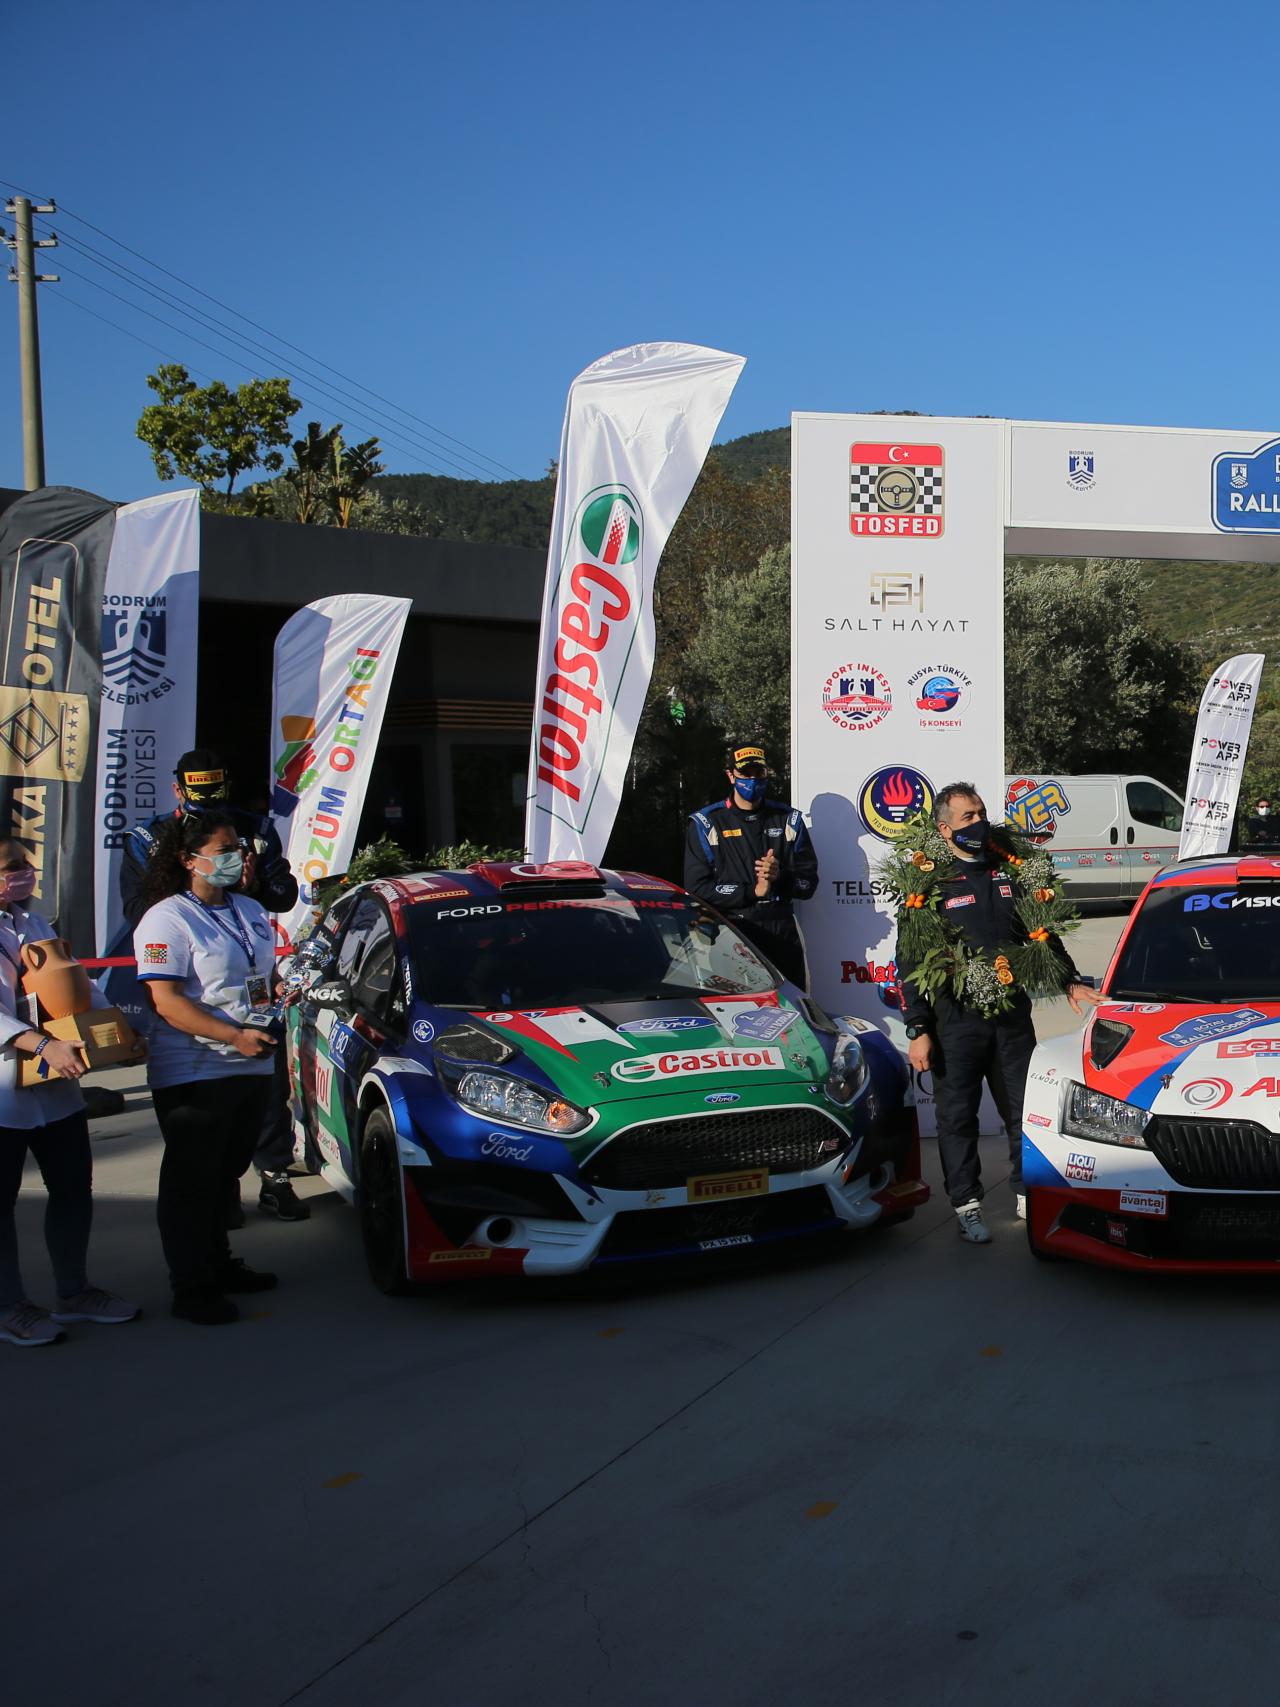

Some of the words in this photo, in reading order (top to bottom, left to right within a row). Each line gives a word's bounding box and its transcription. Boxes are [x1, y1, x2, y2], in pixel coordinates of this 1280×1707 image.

[855, 517, 938, 535] TOSFED
[22, 577, 63, 685] OTEL
[824, 618, 882, 631] SALT
[892, 619, 970, 633] HAYAT
[538, 562, 631, 802] Castrol
[824, 663, 854, 693] SPORT
[857, 663, 892, 693] INVEST
[907, 664, 973, 687] RUSYA-TÜRKİYE
[100, 676, 176, 705] ELEDİYESİ
[1213, 678, 1253, 694] POWER
[1227, 691, 1250, 703] APP
[329, 647, 381, 773] ORTAĞI
[832, 715, 884, 731] BODRUM
[919, 718, 927, 727] İŞ
[928, 719, 962, 727] KONSEYİ
[1201, 737, 1241, 753] POWER
[1216, 750, 1239, 762] APP
[104, 729, 128, 850] BODRUM
[1190, 796, 1229, 813] POWER
[1205, 810, 1228, 822] APP
[437, 904, 502, 921] FORD
[506, 899, 686, 913] PERFORMANCE
[841, 961, 897, 984] Polat
[308, 989, 345, 1002] NGK
[639, 1017, 698, 1031] Ford
[1179, 1030, 1214, 1045] RALLY
[1214, 1014, 1261, 1033] BODRUM
[658, 1048, 776, 1074] Castrol
[710, 1094, 735, 1103] Ford
[481, 1132, 534, 1162] Ford
[1069, 1154, 1095, 1169] LIQUI
[1066, 1166, 1093, 1181] MOLY
[694, 1173, 764, 1197] PIRELLI
[1121, 1196, 1165, 1210] avantaj
